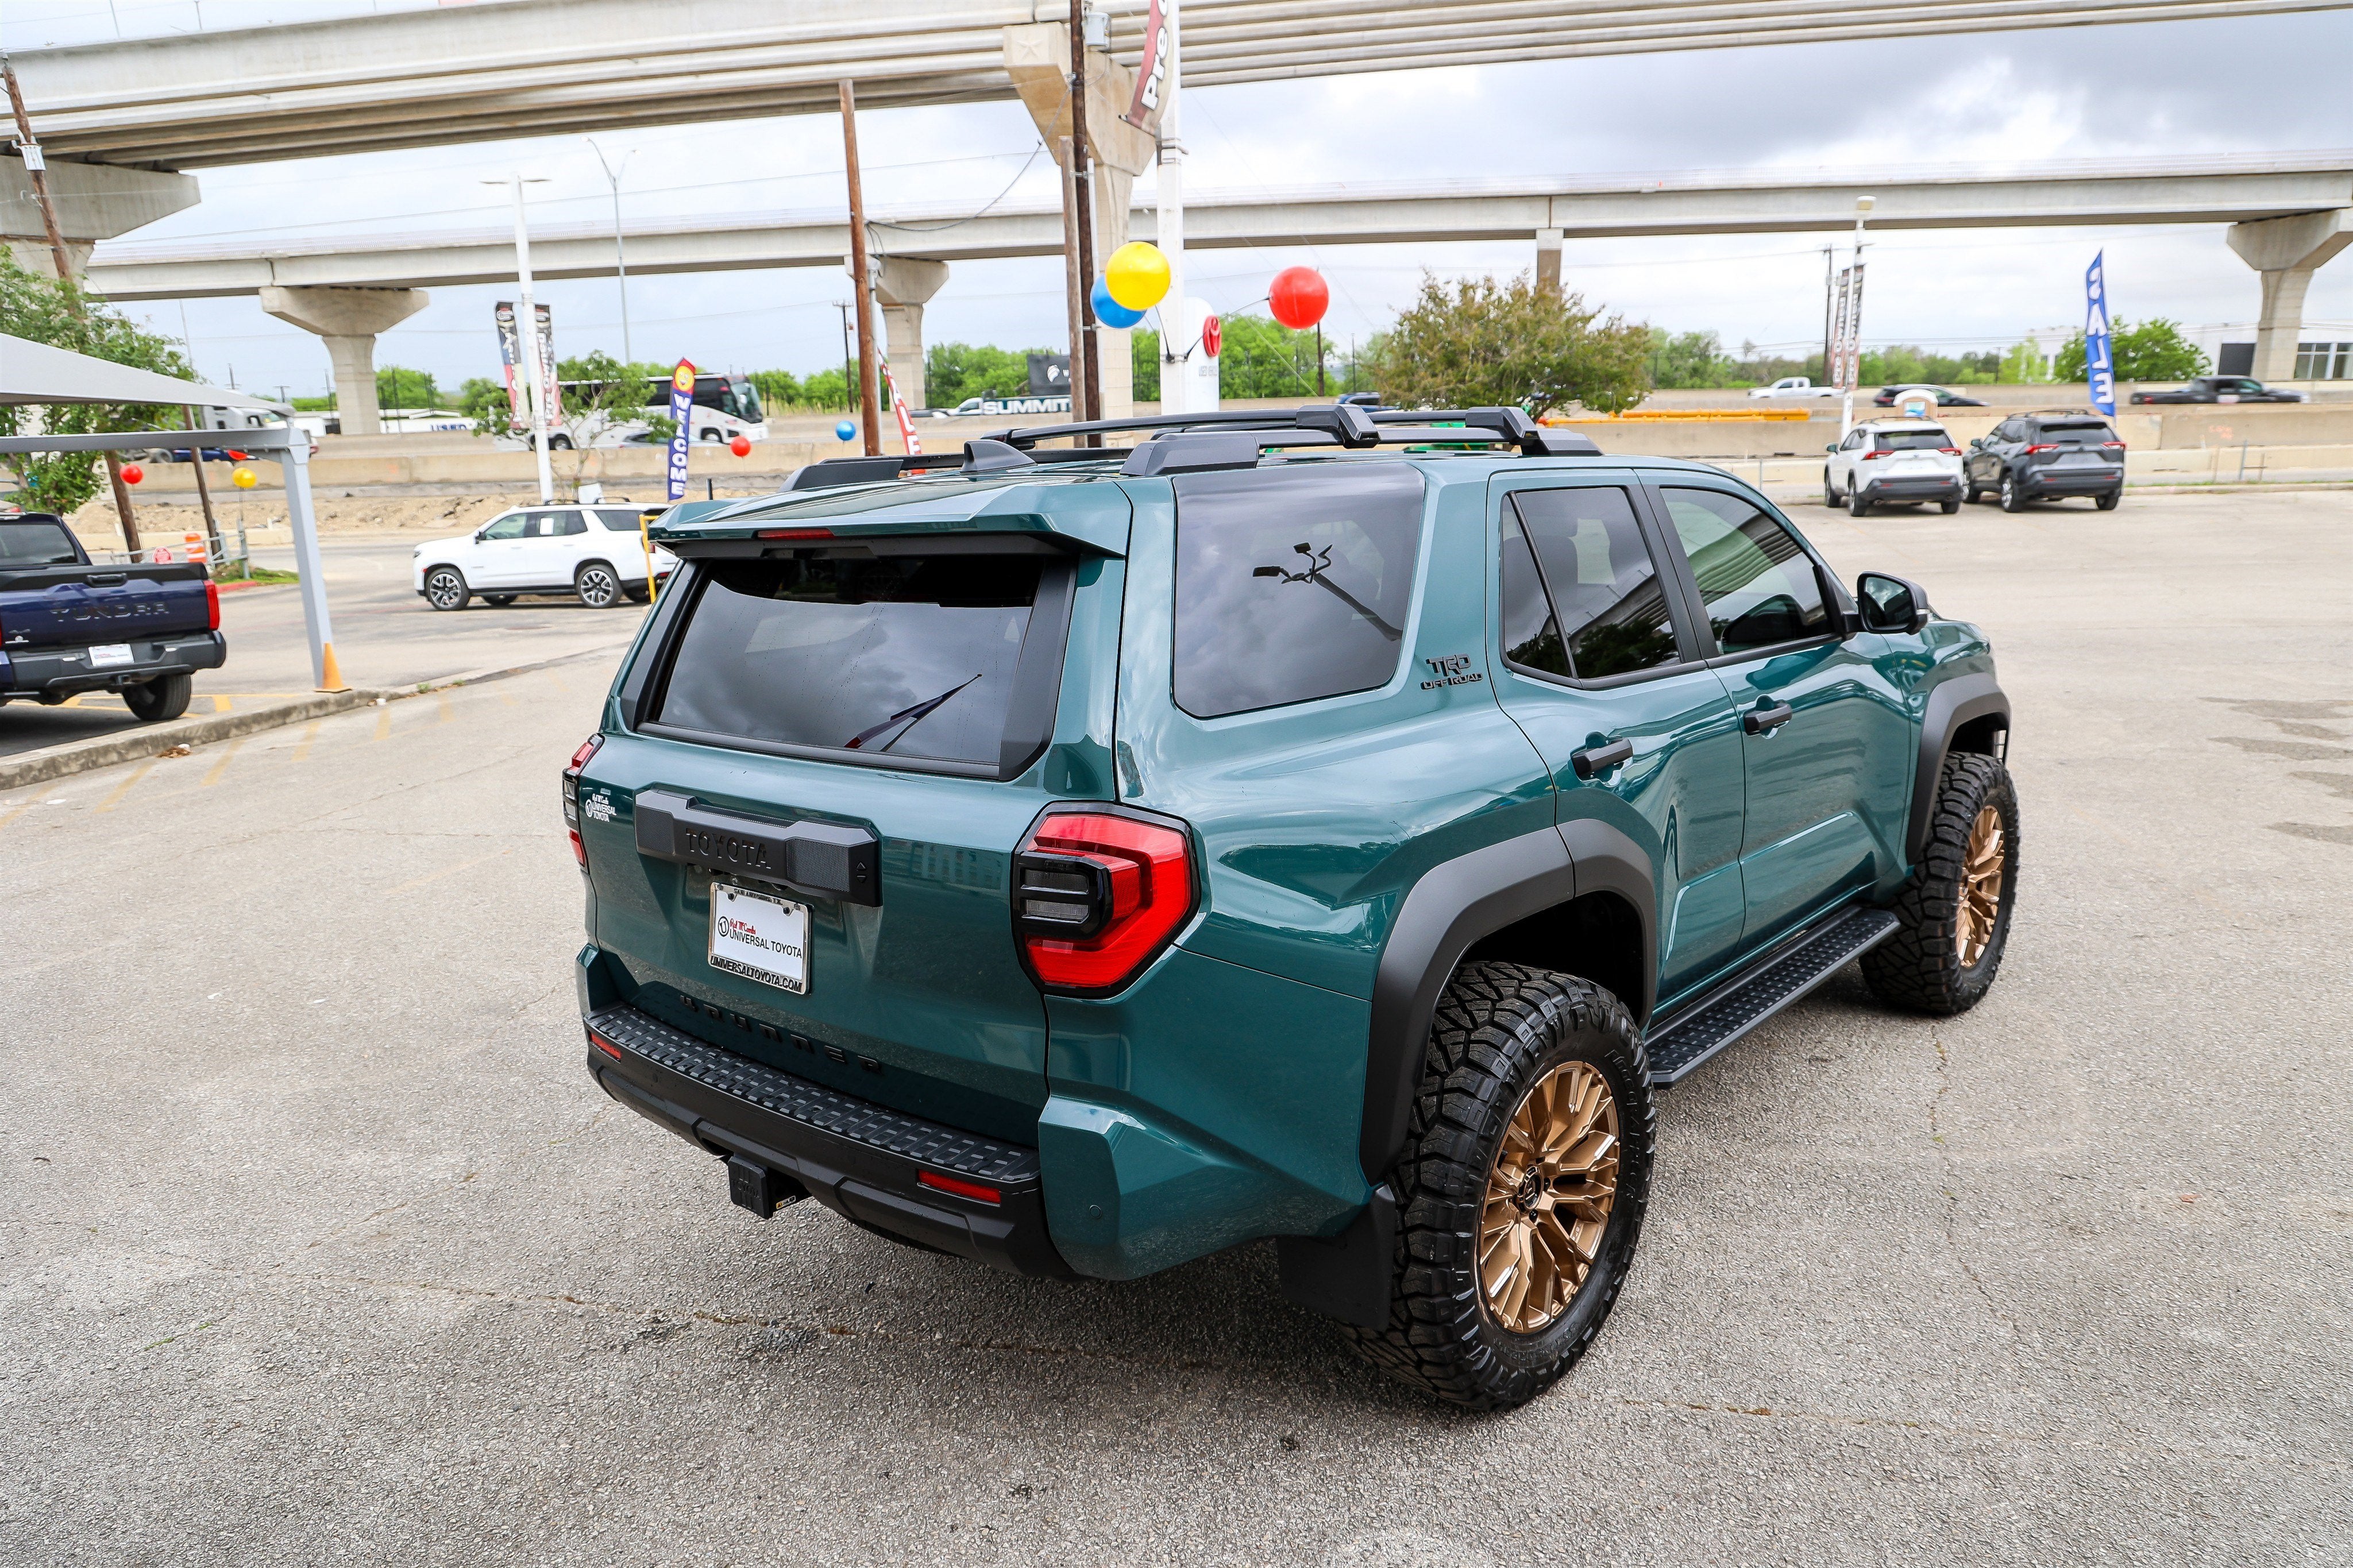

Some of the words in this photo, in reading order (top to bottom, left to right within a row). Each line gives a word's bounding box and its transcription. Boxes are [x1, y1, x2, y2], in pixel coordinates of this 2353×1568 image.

[1140, 27, 1168, 111] Pre
[983, 399, 1070, 415] SUMMIT
[670, 393, 691, 496] WELCOME
[49, 602, 169, 622] TUNDRA
[1425, 654, 1471, 677] TRD
[1420, 679, 1448, 690] OFF
[1448, 673, 1483, 686] ROAD
[592, 801, 617, 816] UNIVERSAL
[593, 810, 610, 822] TOYOTA
[686, 828, 772, 870] TOYOTA
[730, 929, 770, 950] UNIVERSAL
[771, 941, 803, 959] TOYOTA
[711, 955, 803, 994] UNIVERSALTOYOTA.COM
[680, 995, 882, 1075] 4RUNNER
